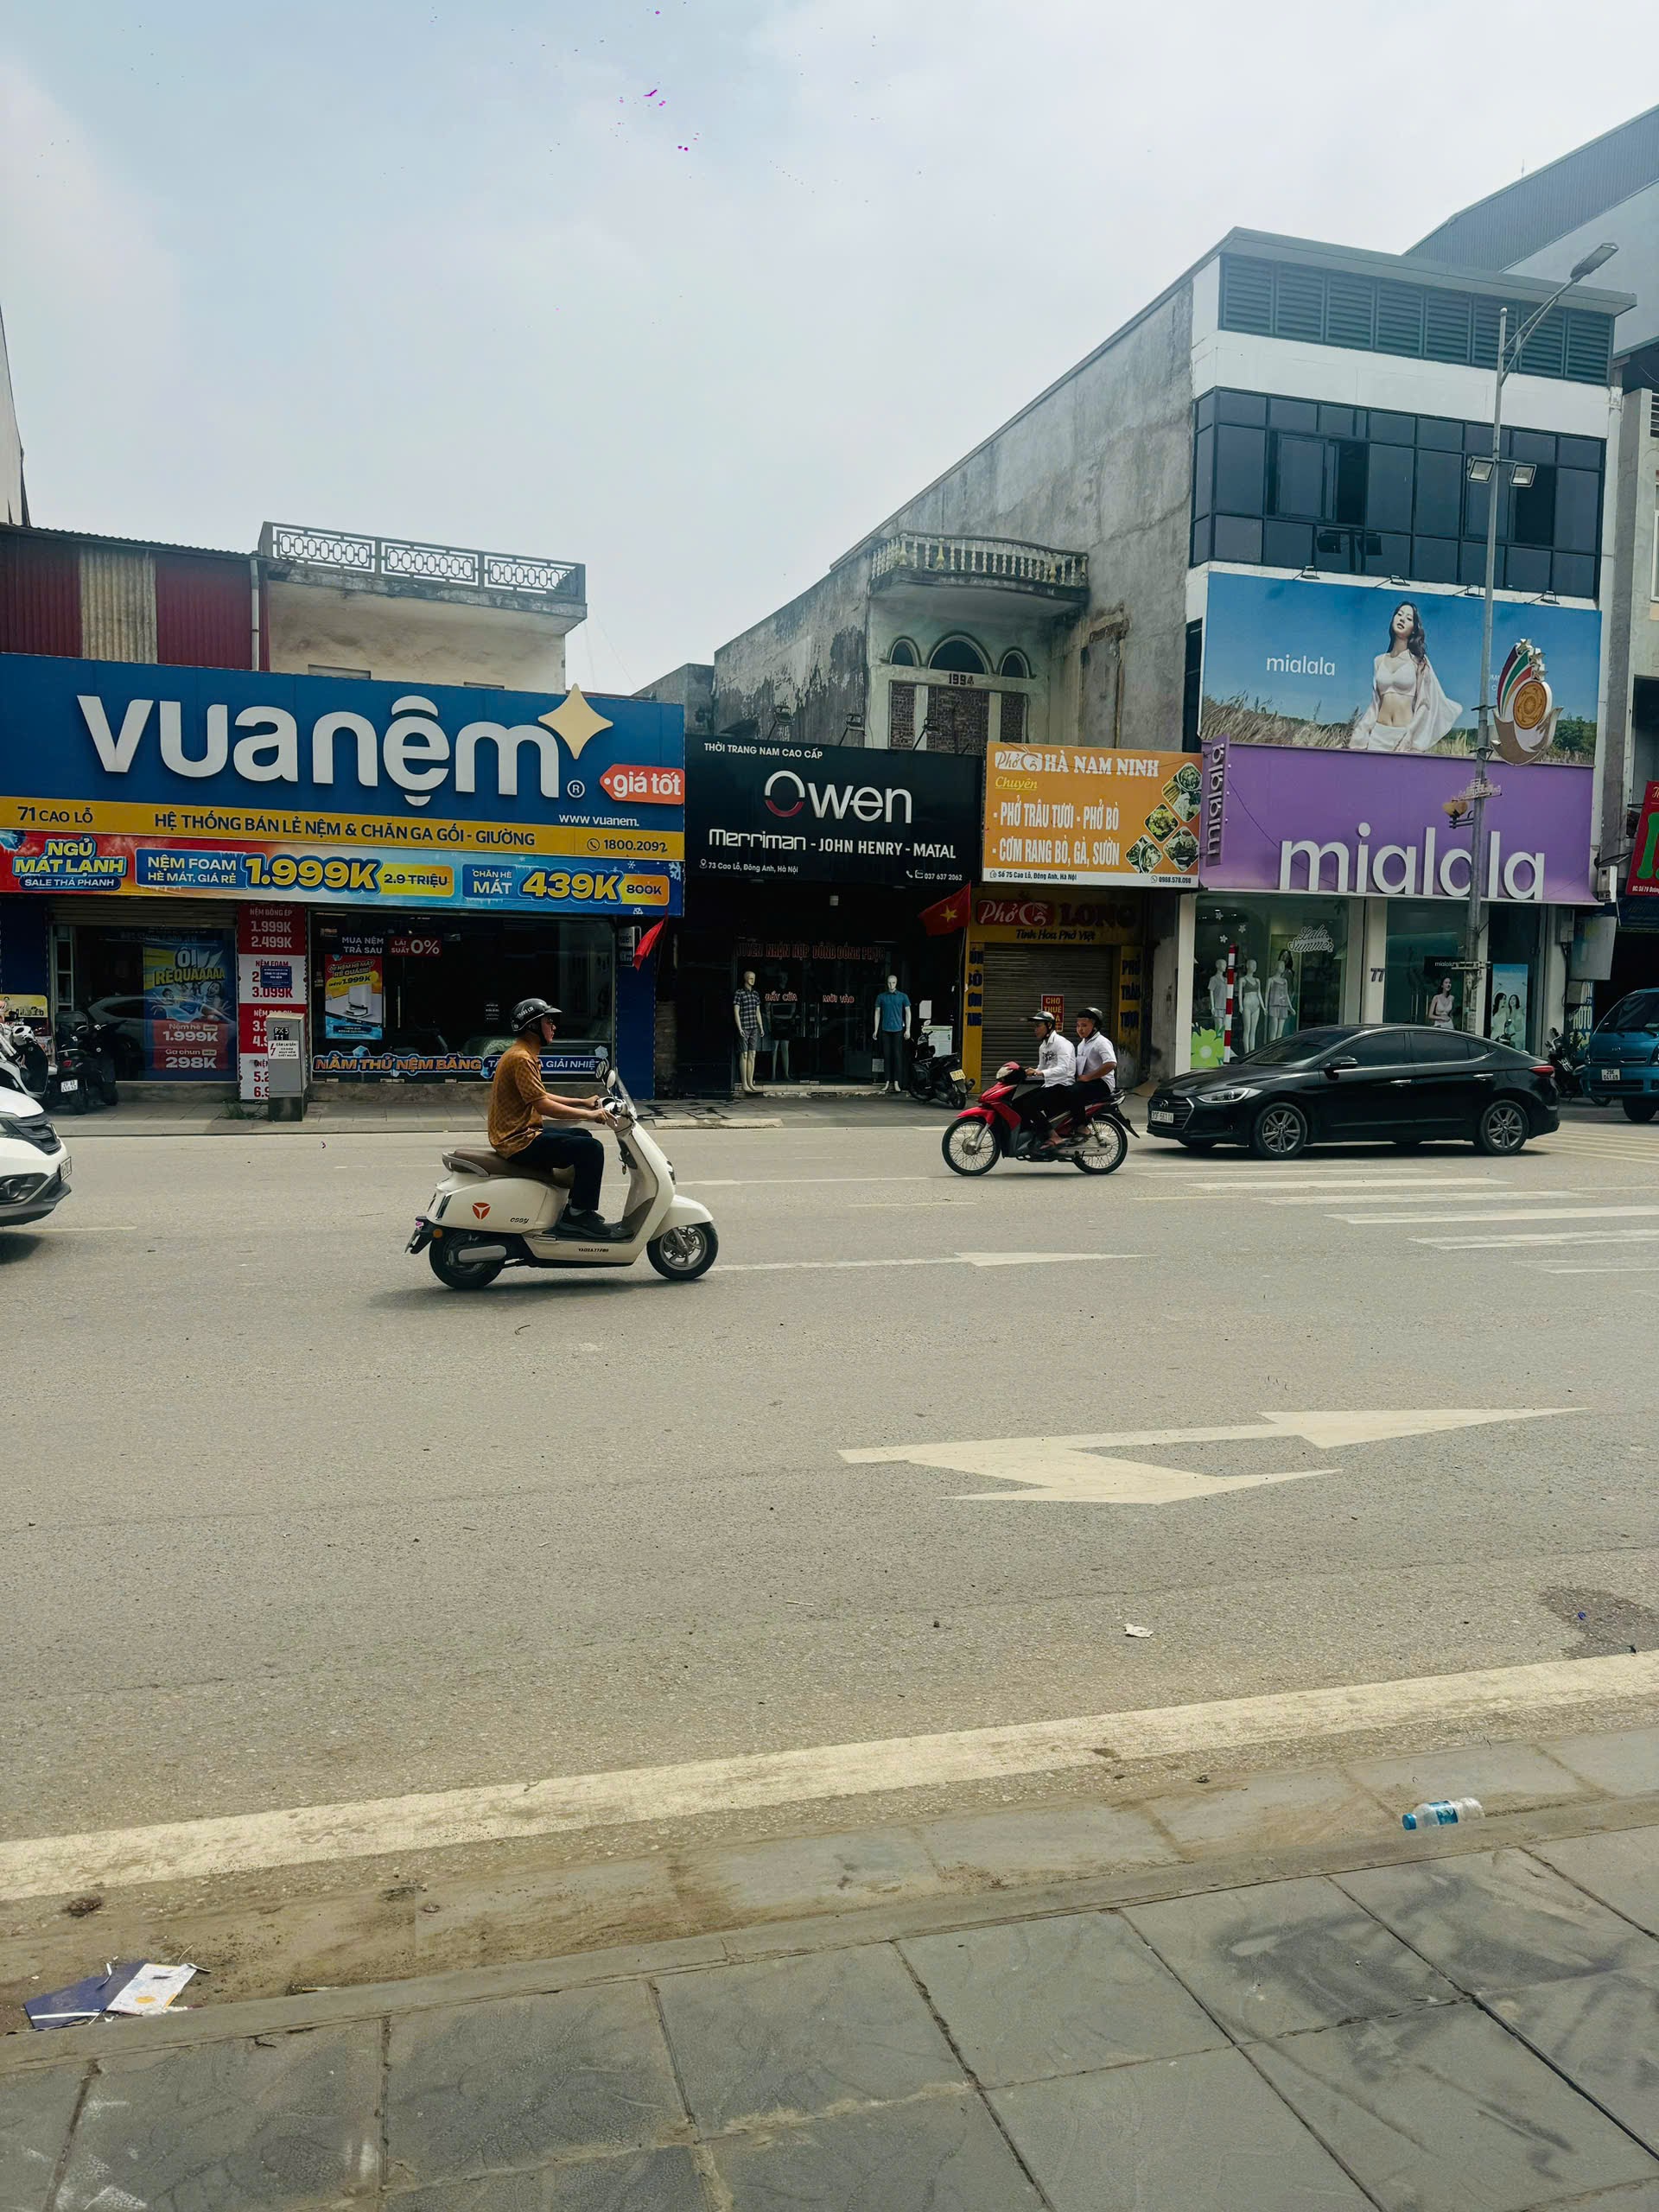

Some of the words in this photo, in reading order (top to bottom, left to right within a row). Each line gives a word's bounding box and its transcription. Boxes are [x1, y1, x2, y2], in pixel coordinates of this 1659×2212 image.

[1266, 654, 1336, 677] mialala
[949, 673, 974, 686] 1994
[704, 741, 726, 753] THỜI
[727, 744, 758, 755] TRANG
[759, 746, 780, 757] NAM
[782, 748, 803, 759] CAO
[804, 747, 823, 760] CẤP
[995, 751, 1020, 770] Phở
[1044, 750, 1070, 773] HÀ
[1074, 754, 1113, 775] NAM
[1116, 758, 1160, 778] NINH
[613, 773, 647, 798] giá
[651, 771, 681, 797] tốt
[995, 776, 1038, 791] Chuyên
[764, 770, 912, 823] Owen
[1206, 742, 1225, 855] mialala
[17, 806, 35, 822] 71
[39, 810, 70, 823] CAO
[74, 807, 93, 823] LỖ
[1000, 794, 1022, 827] PHỞ
[1023, 798, 1050, 829] TRÂU
[1052, 802, 1075, 829] TƯƠI
[1083, 798, 1104, 830] PHỞ
[1105, 801, 1119, 831] BÒ
[155, 811, 177, 830] HỆ
[181, 810, 241, 831] THỐNG
[245, 816, 279, 832] BÁN
[283, 816, 302, 834] LẺ
[305, 819, 340, 838] NỆM
[345, 823, 357, 836] &
[361, 823, 408, 840] CHĂN
[410, 827, 433, 841] GA
[436, 823, 464, 842] GỐI
[476, 829, 536, 846] GIƯỜNG
[48, 838, 93, 856] NGỦ
[603, 839, 668, 853] 1800.2092
[818, 837, 854, 855] JOHN
[858, 840, 903, 856] HENRY
[912, 842, 957, 859] MATAL
[999, 836, 1022, 862] CƠM
[1025, 838, 1052, 863] RANG
[1054, 835, 1071, 868] BÒ,
[1073, 836, 1090, 868] GÀ,
[1092, 836, 1120, 866] SƯỜN
[15, 855, 63, 873] MÁT
[66, 859, 124, 877] LẠNH
[148, 854, 185, 871] NỆM
[188, 858, 237, 871] FOAM
[1280, 822, 1545, 900] mialala
[148, 871, 164, 881] HÈ
[167, 871, 196, 883] MÁT,
[198, 872, 219, 884] GIÁ
[221, 873, 237, 884] RẺ
[245, 857, 378, 890] 1.999K
[473, 869, 499, 878] CHĂN
[787, 866, 798, 874] Nội
[24, 878, 52, 887] SALE
[54, 877, 76, 887] THẢ
[384, 874, 406, 884] 2.9
[407, 874, 448, 888] TRIỆU
[474, 879, 512, 894] MÁT
[522, 871, 620, 900] 439K
[626, 885, 662, 895] 800K
[250, 907, 266, 917] NỆM
[978, 900, 1018, 924] Phở
[251, 920, 292, 933] 1.999K
[1298, 924, 1329, 940] Lala
[251, 936, 292, 949] 2.499K
[365, 936, 384, 945] NỆM
[410, 939, 441, 955] 0%
[1287, 937, 1334, 952] Summer
[343, 944, 364, 954] TRẢ
[1370, 967, 1385, 982] 77
[251, 987, 294, 998] 3.099K
[162, 1030, 219, 1042] 1.999K
[165, 1057, 217, 1069] 298K
[315, 1053, 357, 1071] NẰM
[359, 1054, 394, 1071] THỬ
[396, 1055, 434, 1075] NỆM
[435, 1054, 481, 1071] BĂNG
[546, 1058, 568, 1068] GIẢI
